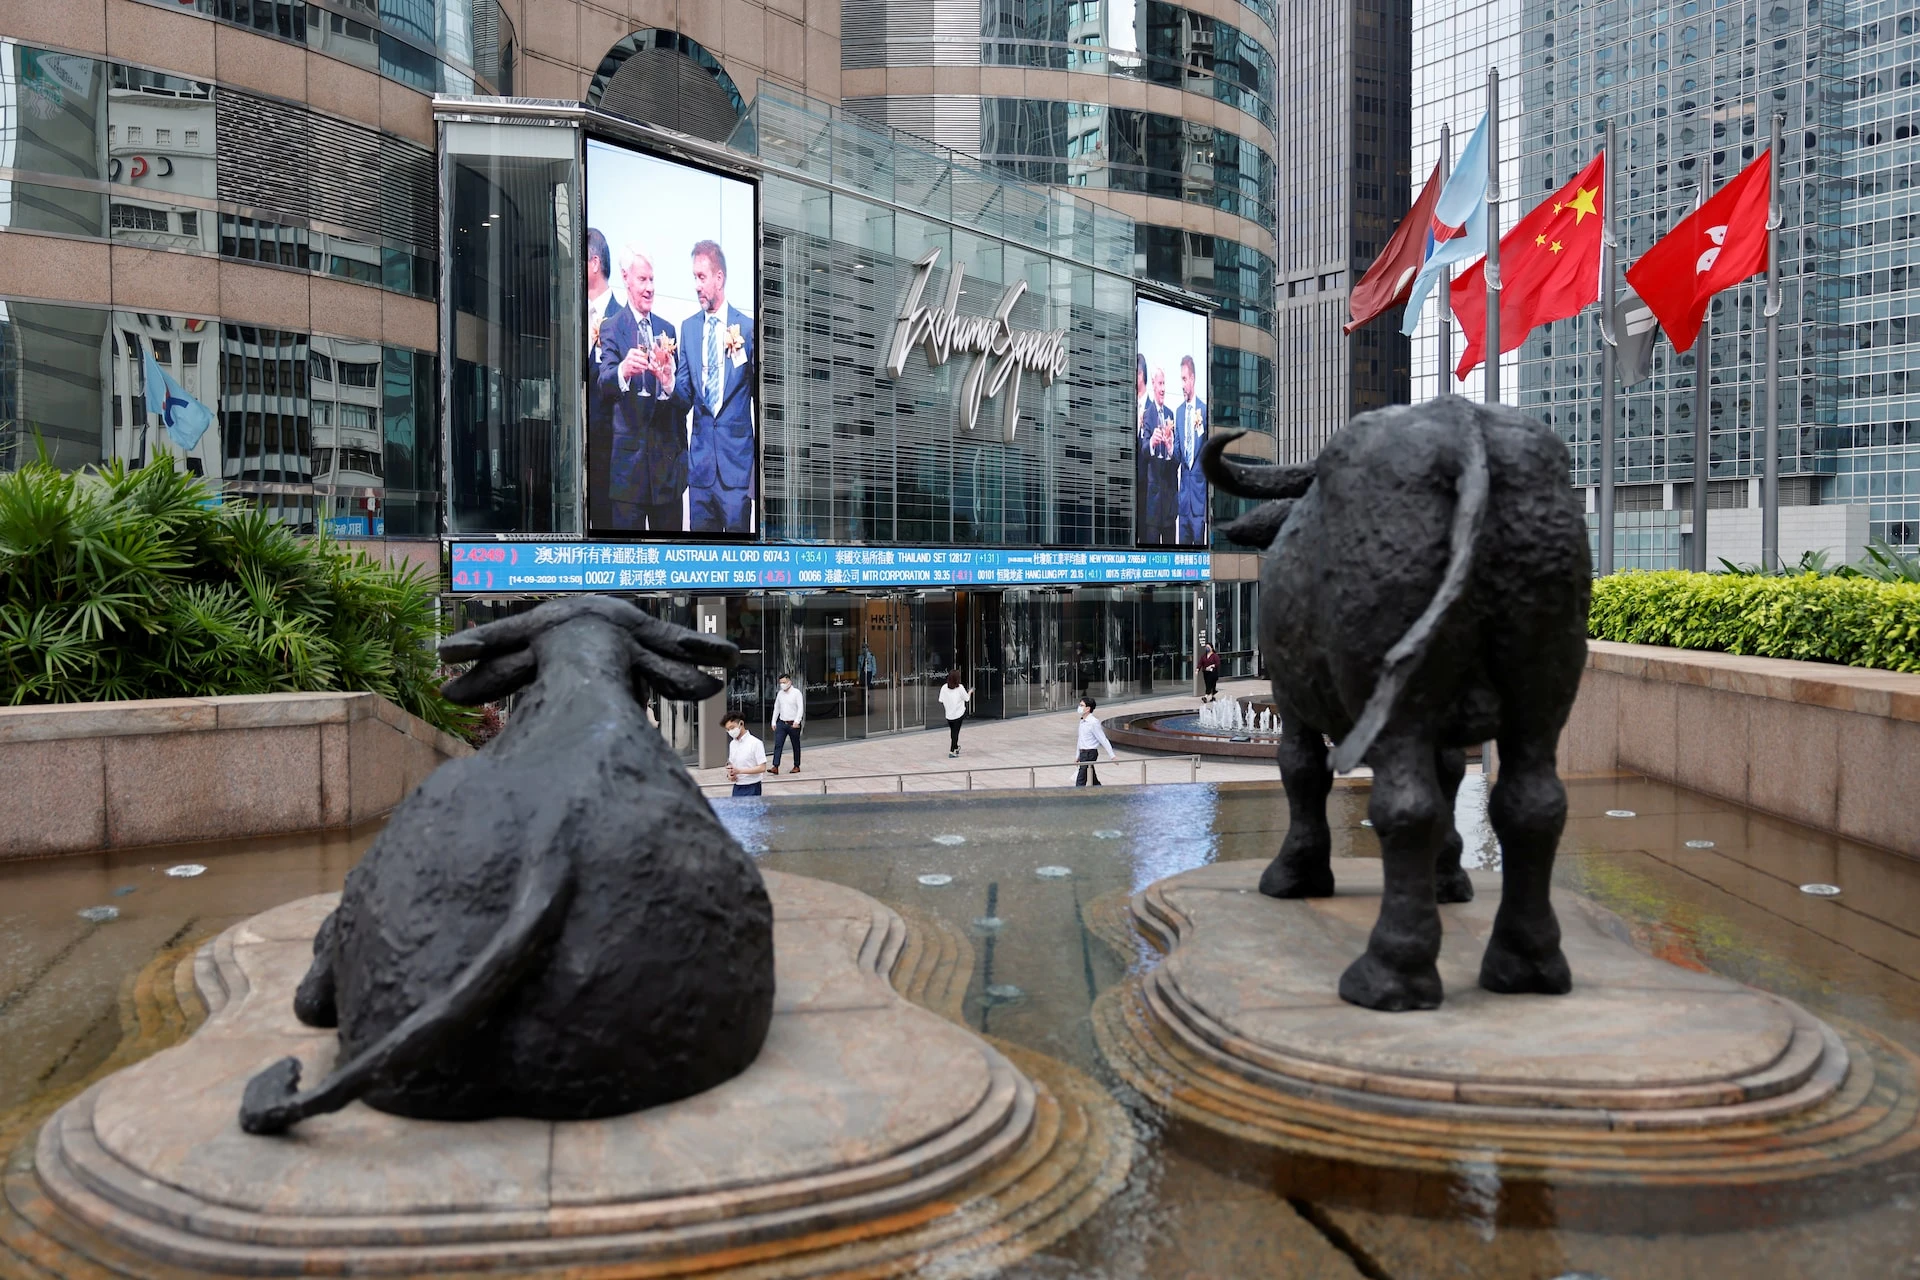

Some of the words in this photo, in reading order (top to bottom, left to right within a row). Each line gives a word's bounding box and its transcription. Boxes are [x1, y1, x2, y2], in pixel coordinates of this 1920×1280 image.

[887, 246, 1003, 432] Exchange
[982, 279, 1068, 443] Square
[452, 547, 505, 562] 2.4249
[534, 546, 660, 564] 澳洲所有普通股指數
[665, 549, 718, 562] AUSTRALIA
[722, 549, 738, 562] ALL
[740, 550, 760, 562] ORD
[763, 550, 789, 562] 6074.3
[897, 552, 931, 563] THAILAND
[933, 552, 946, 563] SET
[949, 553, 971, 563] 1281.27
[1089, 554, 1100, 563] NEW
[585, 571, 615, 584] 00027
[670, 571, 709, 583] GALAXY
[711, 570, 730, 583] ENT
[733, 570, 757, 583] 59.05
[799, 570, 821, 582] 00066
[862, 570, 879, 581] MTR
[879, 570, 931, 581] CORPORATION
[933, 570, 951, 581] 39.35
[978, 570, 995, 580] 00101
[1025, 570, 1041, 579] HANG
[1041, 569, 1057, 579] LUNG
